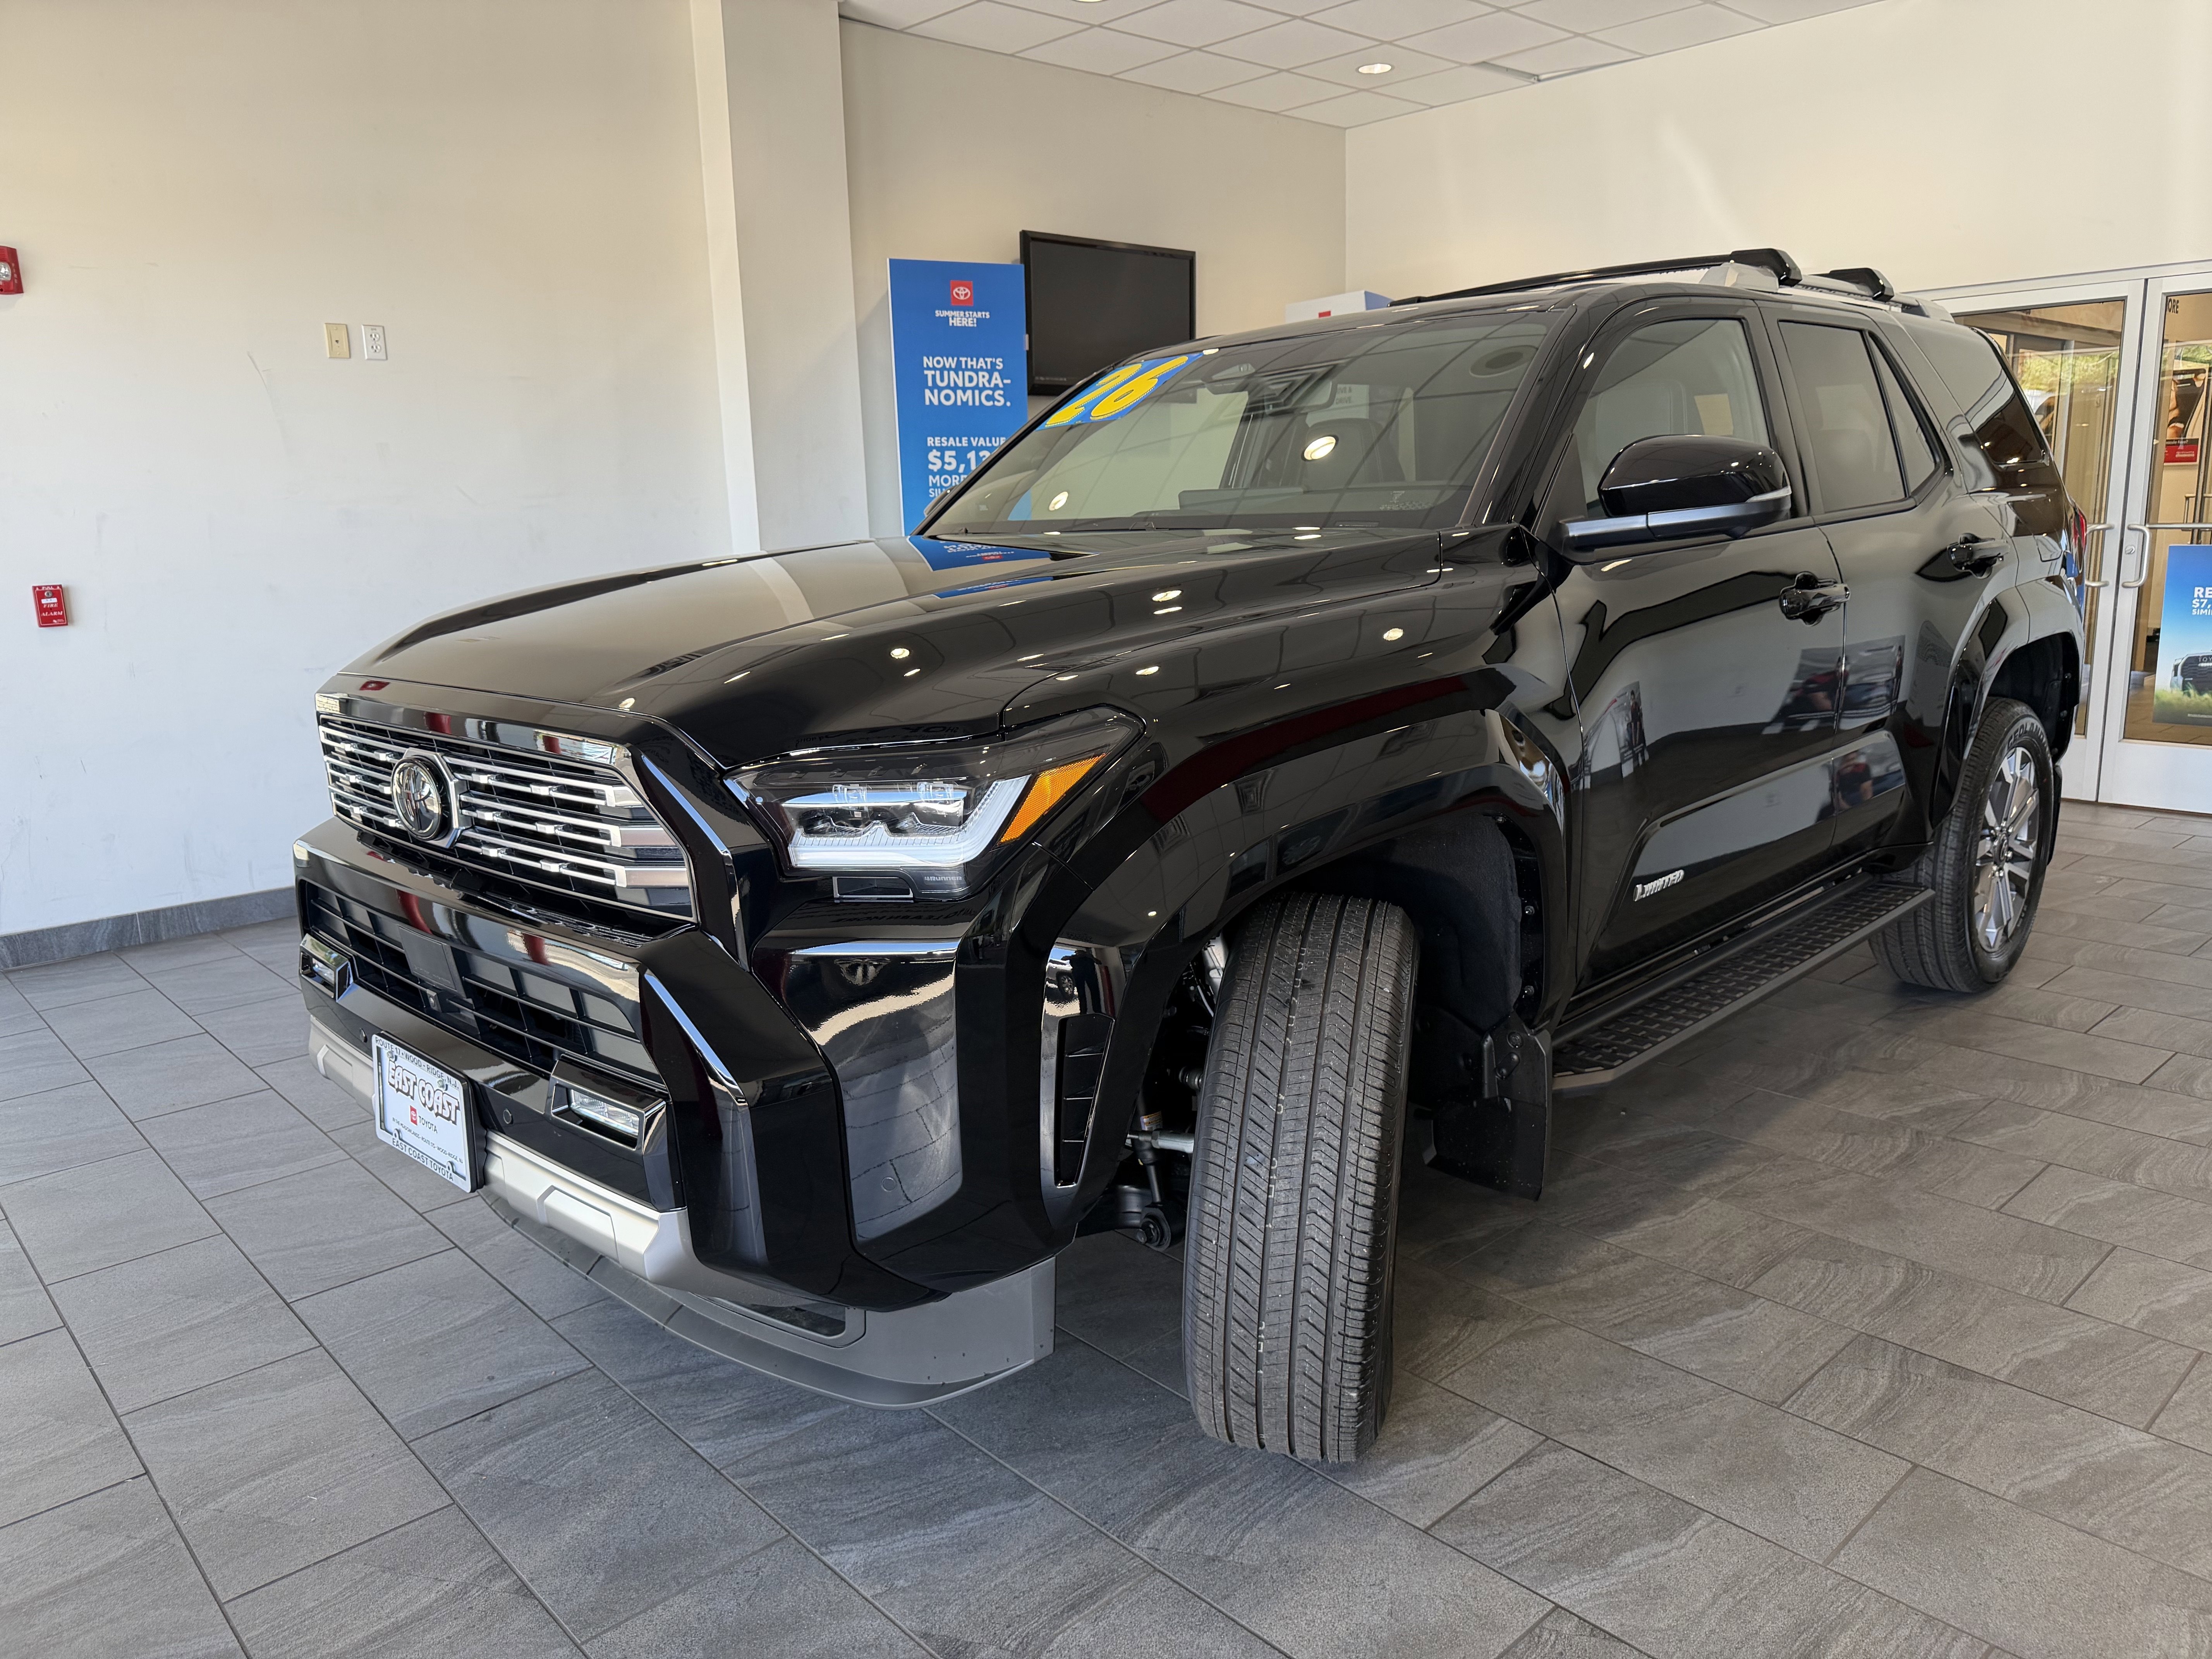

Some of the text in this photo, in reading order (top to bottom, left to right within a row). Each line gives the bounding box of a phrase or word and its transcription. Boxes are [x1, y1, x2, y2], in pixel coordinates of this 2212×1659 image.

[949, 318, 977, 327] HERE!
[923, 356, 1003, 369] NOW THAT'S
[924, 370, 1011, 388] TUNDRA-
[924, 388, 1011, 407] NOMICS.
[1045, 356, 1188, 428] 26
[927, 437, 968, 447] RESALE
[1633, 869, 1685, 902] LIMITED
[375, 1037, 394, 1052] ROUTE
[395, 1047, 401, 1055] 17
[404, 1051, 422, 1067] WOOD
[388, 1060, 460, 1126] EAST COAST
[418, 1115, 438, 1134] TOYOTA
[392, 1137, 453, 1181] EAST COAST TOYOTA
